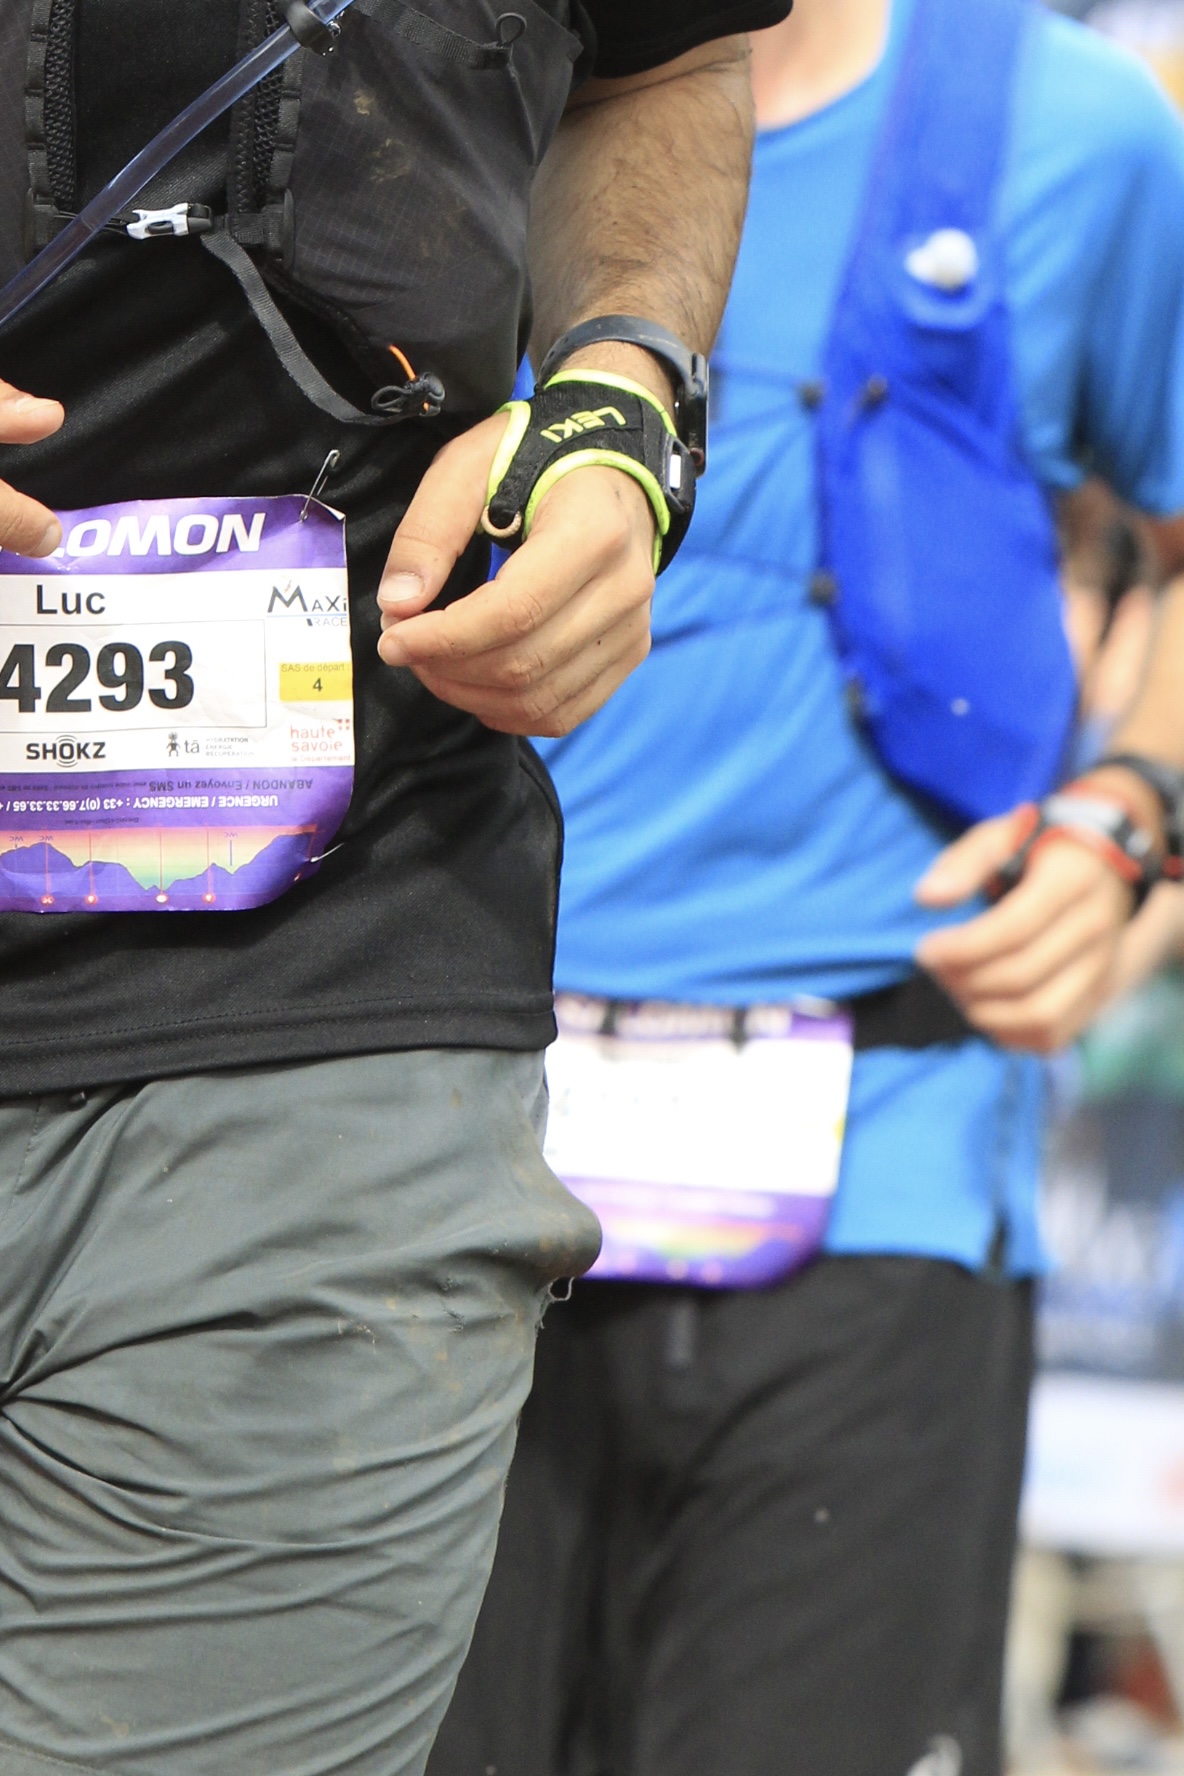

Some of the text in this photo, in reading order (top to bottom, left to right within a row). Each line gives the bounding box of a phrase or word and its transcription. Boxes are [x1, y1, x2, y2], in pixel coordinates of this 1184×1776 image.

[540, 406, 626, 443] LEKI
[36, 584, 106, 615] Luc
[281, 663, 301, 672] SAS
[303, 663, 315, 672] de
[317, 663, 345, 673] départ
[313, 677, 323, 692] 4
[290, 725, 335, 739] haute
[26, 741, 106, 760] SHOKZ
[291, 740, 343, 752] savoie
[149, 781, 174, 791] SMS
[177, 781, 192, 789] un
[195, 779, 242, 790] Envoyez
[253, 779, 313, 790] ABANDON
[12, 797, 101, 812] (0)7.66.33.33.65
[103, 798, 124, 810] +33
[133, 796, 209, 809] EMERGENCY
[218, 795, 278, 808] URGENCE
